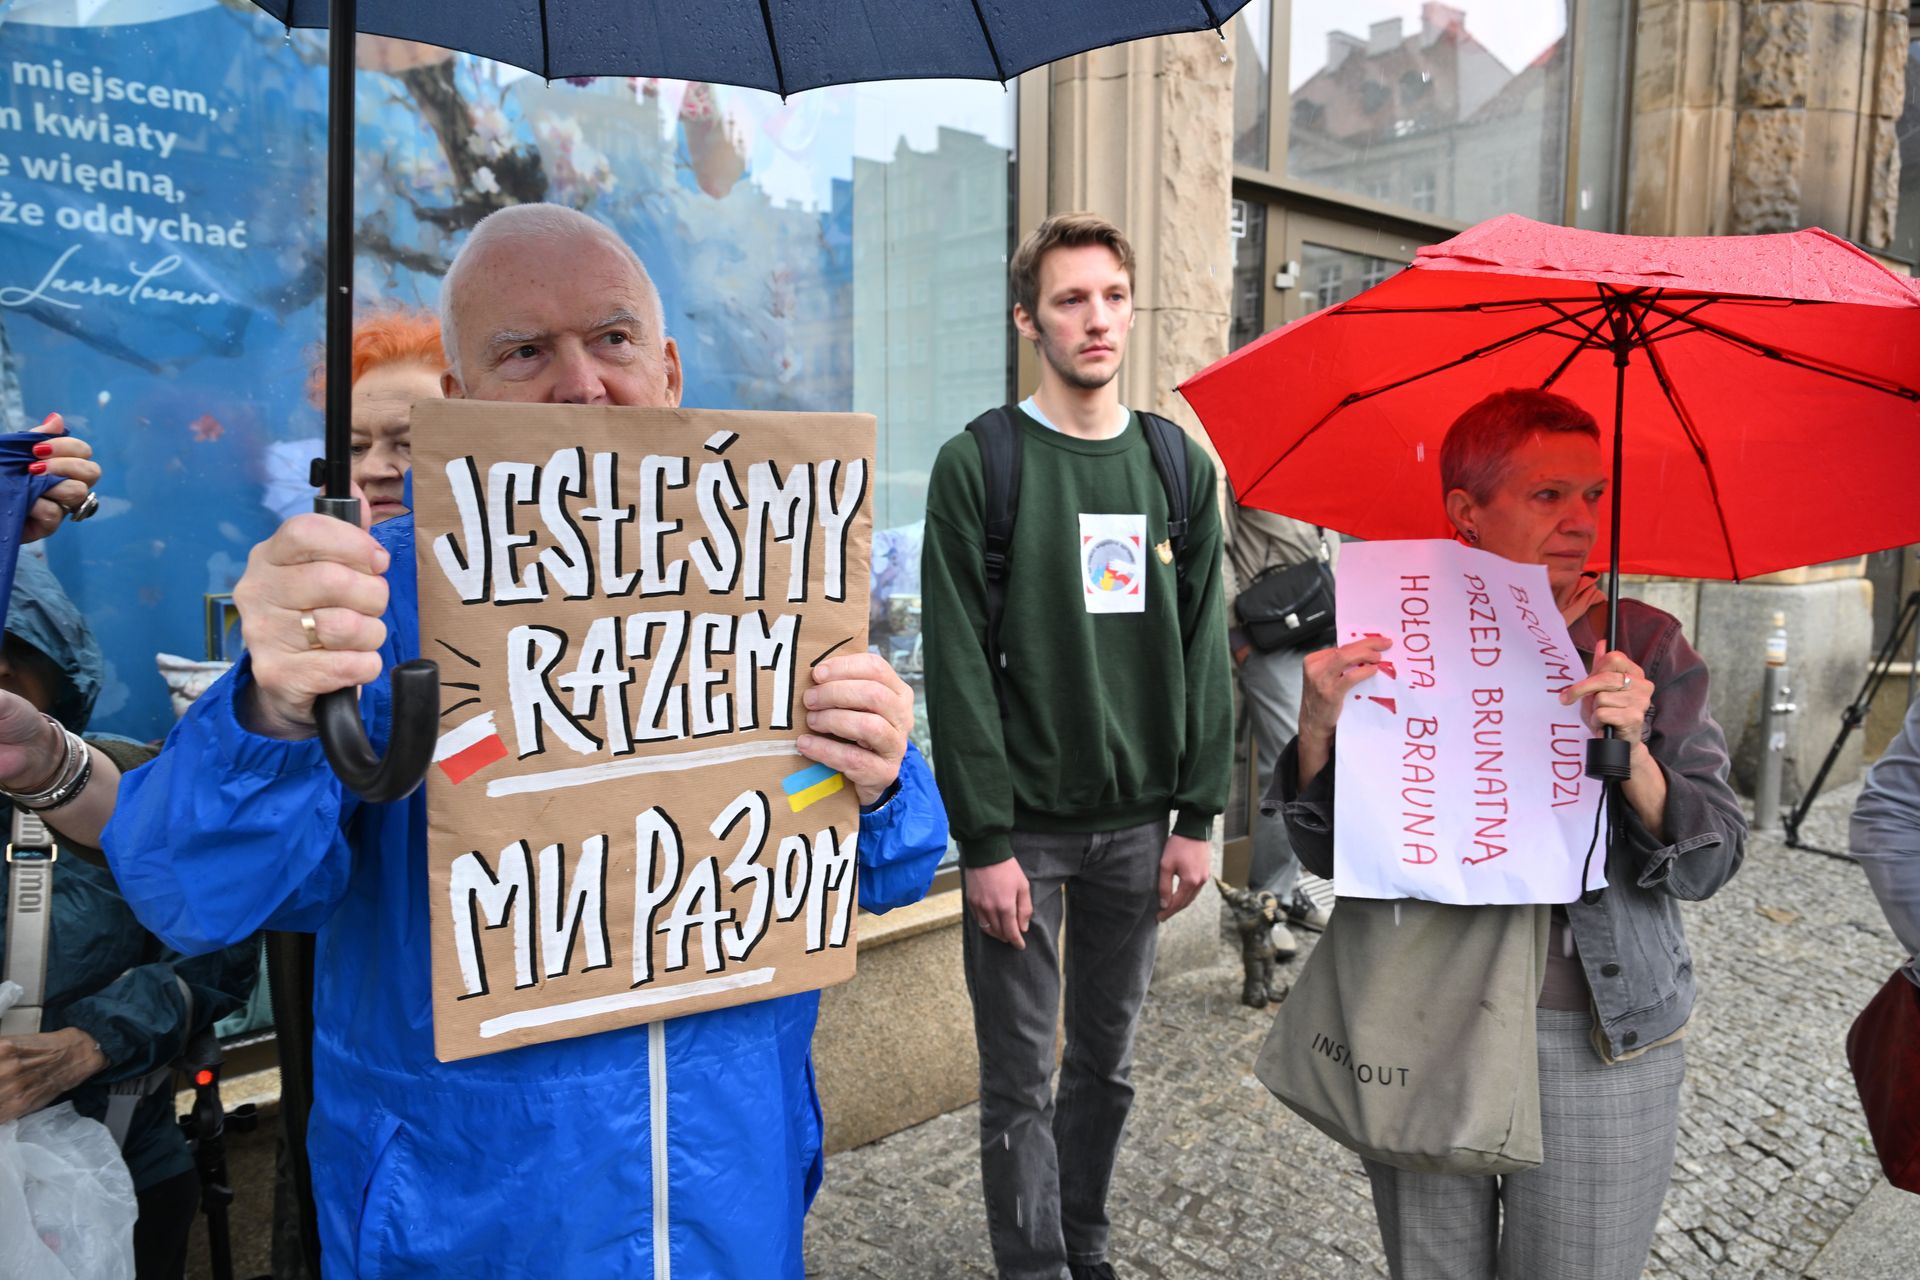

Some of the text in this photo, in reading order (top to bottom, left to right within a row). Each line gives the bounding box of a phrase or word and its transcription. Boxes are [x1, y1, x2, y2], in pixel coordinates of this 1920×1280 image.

[12, 59, 218, 121] miejscem,
[34, 101, 177, 158] kwiaty
[20, 152, 186, 204] więdną,
[55, 202, 248, 250] oddychać
[506, 608, 803, 761] RAZEM
[1461, 572, 1509, 866] PRZED BRUNATNĄ
[1401, 715, 1439, 865] BRAUNA
[1550, 723, 1583, 808] LUDZI
[449, 789, 860, 1002] МИ РАЗОМ
[1357, 1063, 1410, 1087] OUT
